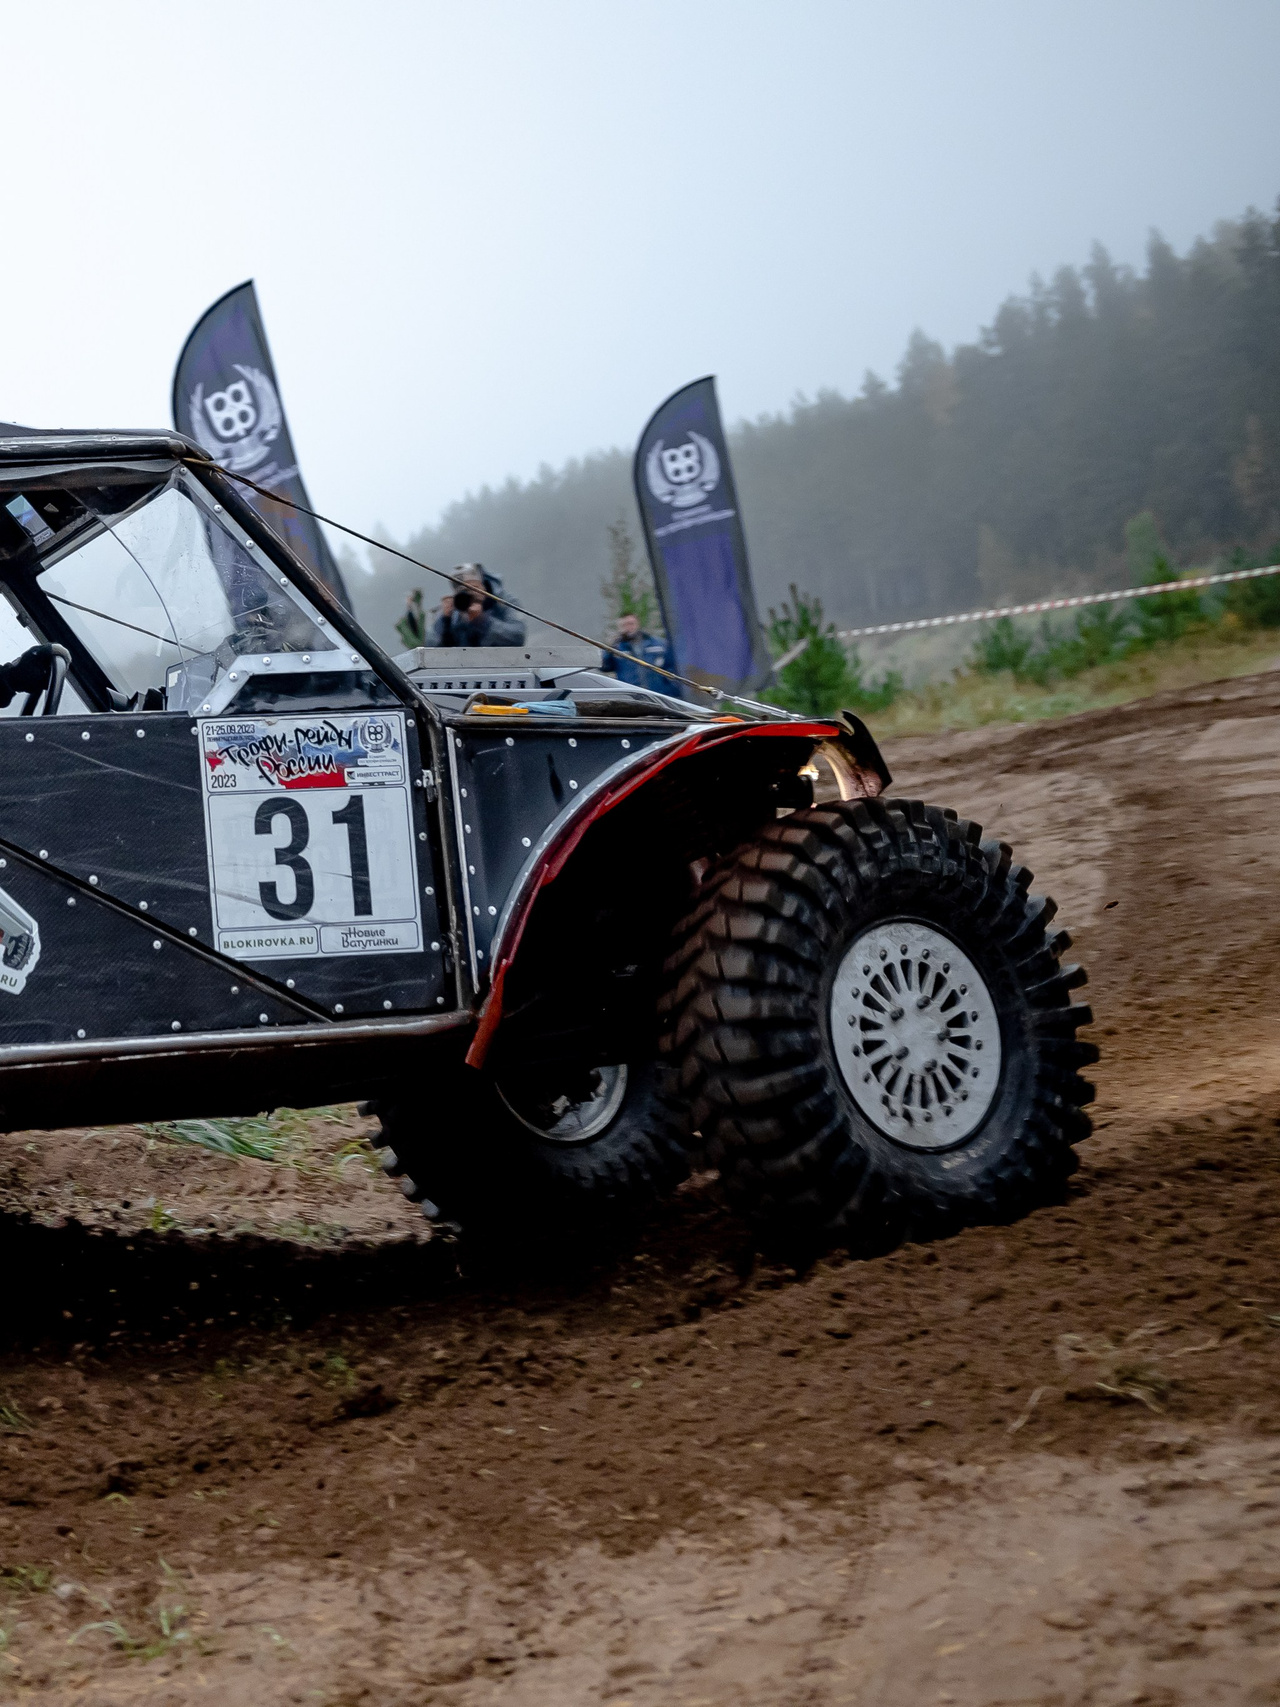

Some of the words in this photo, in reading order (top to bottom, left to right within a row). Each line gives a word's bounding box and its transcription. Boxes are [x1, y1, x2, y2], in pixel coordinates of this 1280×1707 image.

[205, 724, 255, 736] 21-25.09.2023
[256, 753, 338, 786] России
[211, 774, 237, 789] 2023
[254, 794, 374, 921] 31
[342, 927, 386, 938] Новые
[223, 936, 314, 949] BLOKIROVKA.RU
